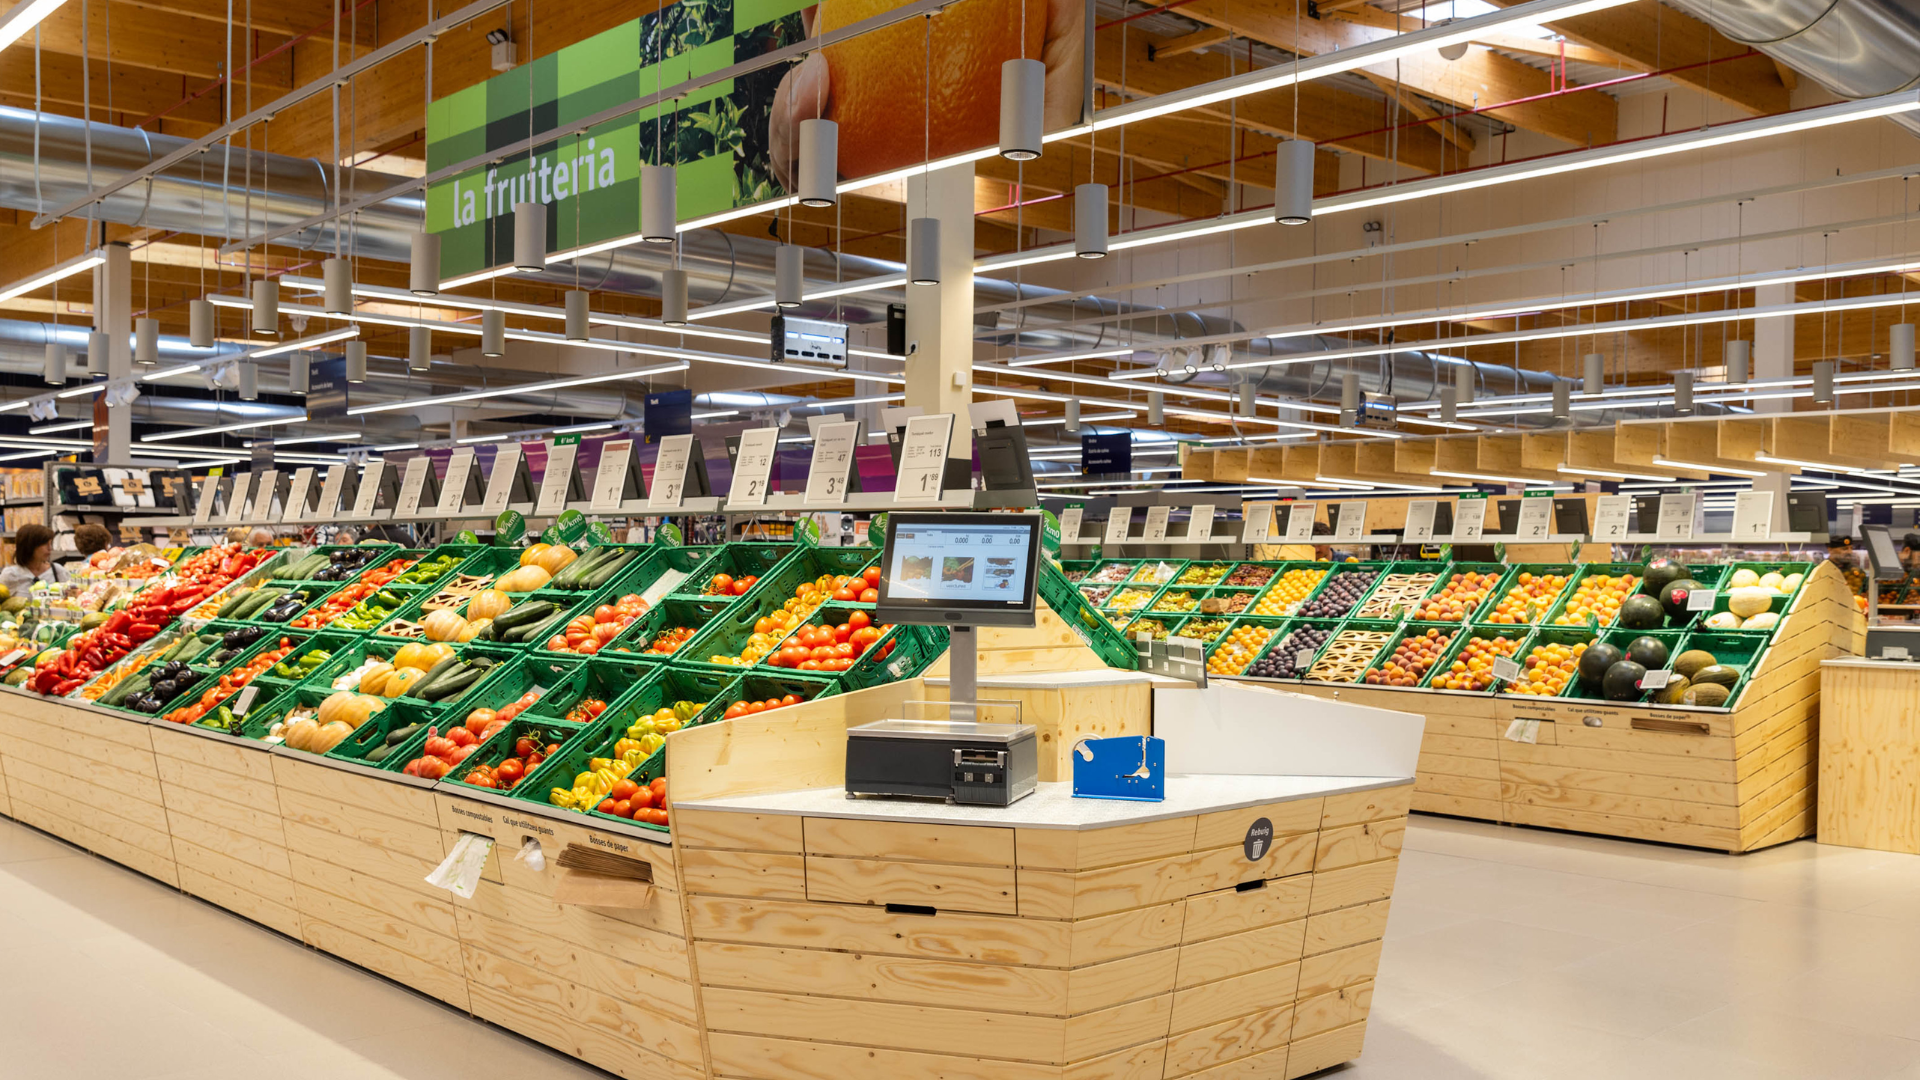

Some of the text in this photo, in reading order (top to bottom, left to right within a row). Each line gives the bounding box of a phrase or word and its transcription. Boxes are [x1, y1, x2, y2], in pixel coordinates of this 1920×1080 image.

[454, 137, 615, 229] la fruiteria
[838, 453, 846, 462] 47
[929, 448, 942, 457] 113
[760, 458, 767, 466] 12
[748, 480, 757, 497] 2
[827, 477, 835, 495] 3
[920, 473, 928, 492] 1
[496, 492, 502, 504] 2
[553, 489, 559, 503] 1
[608, 486, 613, 500] 1
[666, 484, 674, 500] 3
[407, 496, 413, 508] 2
[449, 494, 456, 507] 2
[507, 512, 518, 528] km0
[568, 514, 582, 527] km0
[1046, 525, 1060, 538] km0
[1116, 530, 1121, 538] 2
[1154, 530, 1159, 538] 2
[1299, 528, 1305, 536] 2
[1349, 527, 1355, 536] 3
[1418, 527, 1424, 536] 2
[1467, 526, 1474, 536] 2
[1533, 526, 1539, 535] 2
[1610, 525, 1617, 535] 2
[1675, 524, 1681, 534] 1
[1752, 524, 1757, 533] 1
[667, 535, 680, 547] km0
[805, 529, 818, 544] km0
[451, 805, 493, 824] Bosses compostables
[502, 815, 554, 836] Cal que utilitzeu guants
[1250, 826, 1270, 837] Rebuig
[588, 834, 629, 853] Bosses de paper
